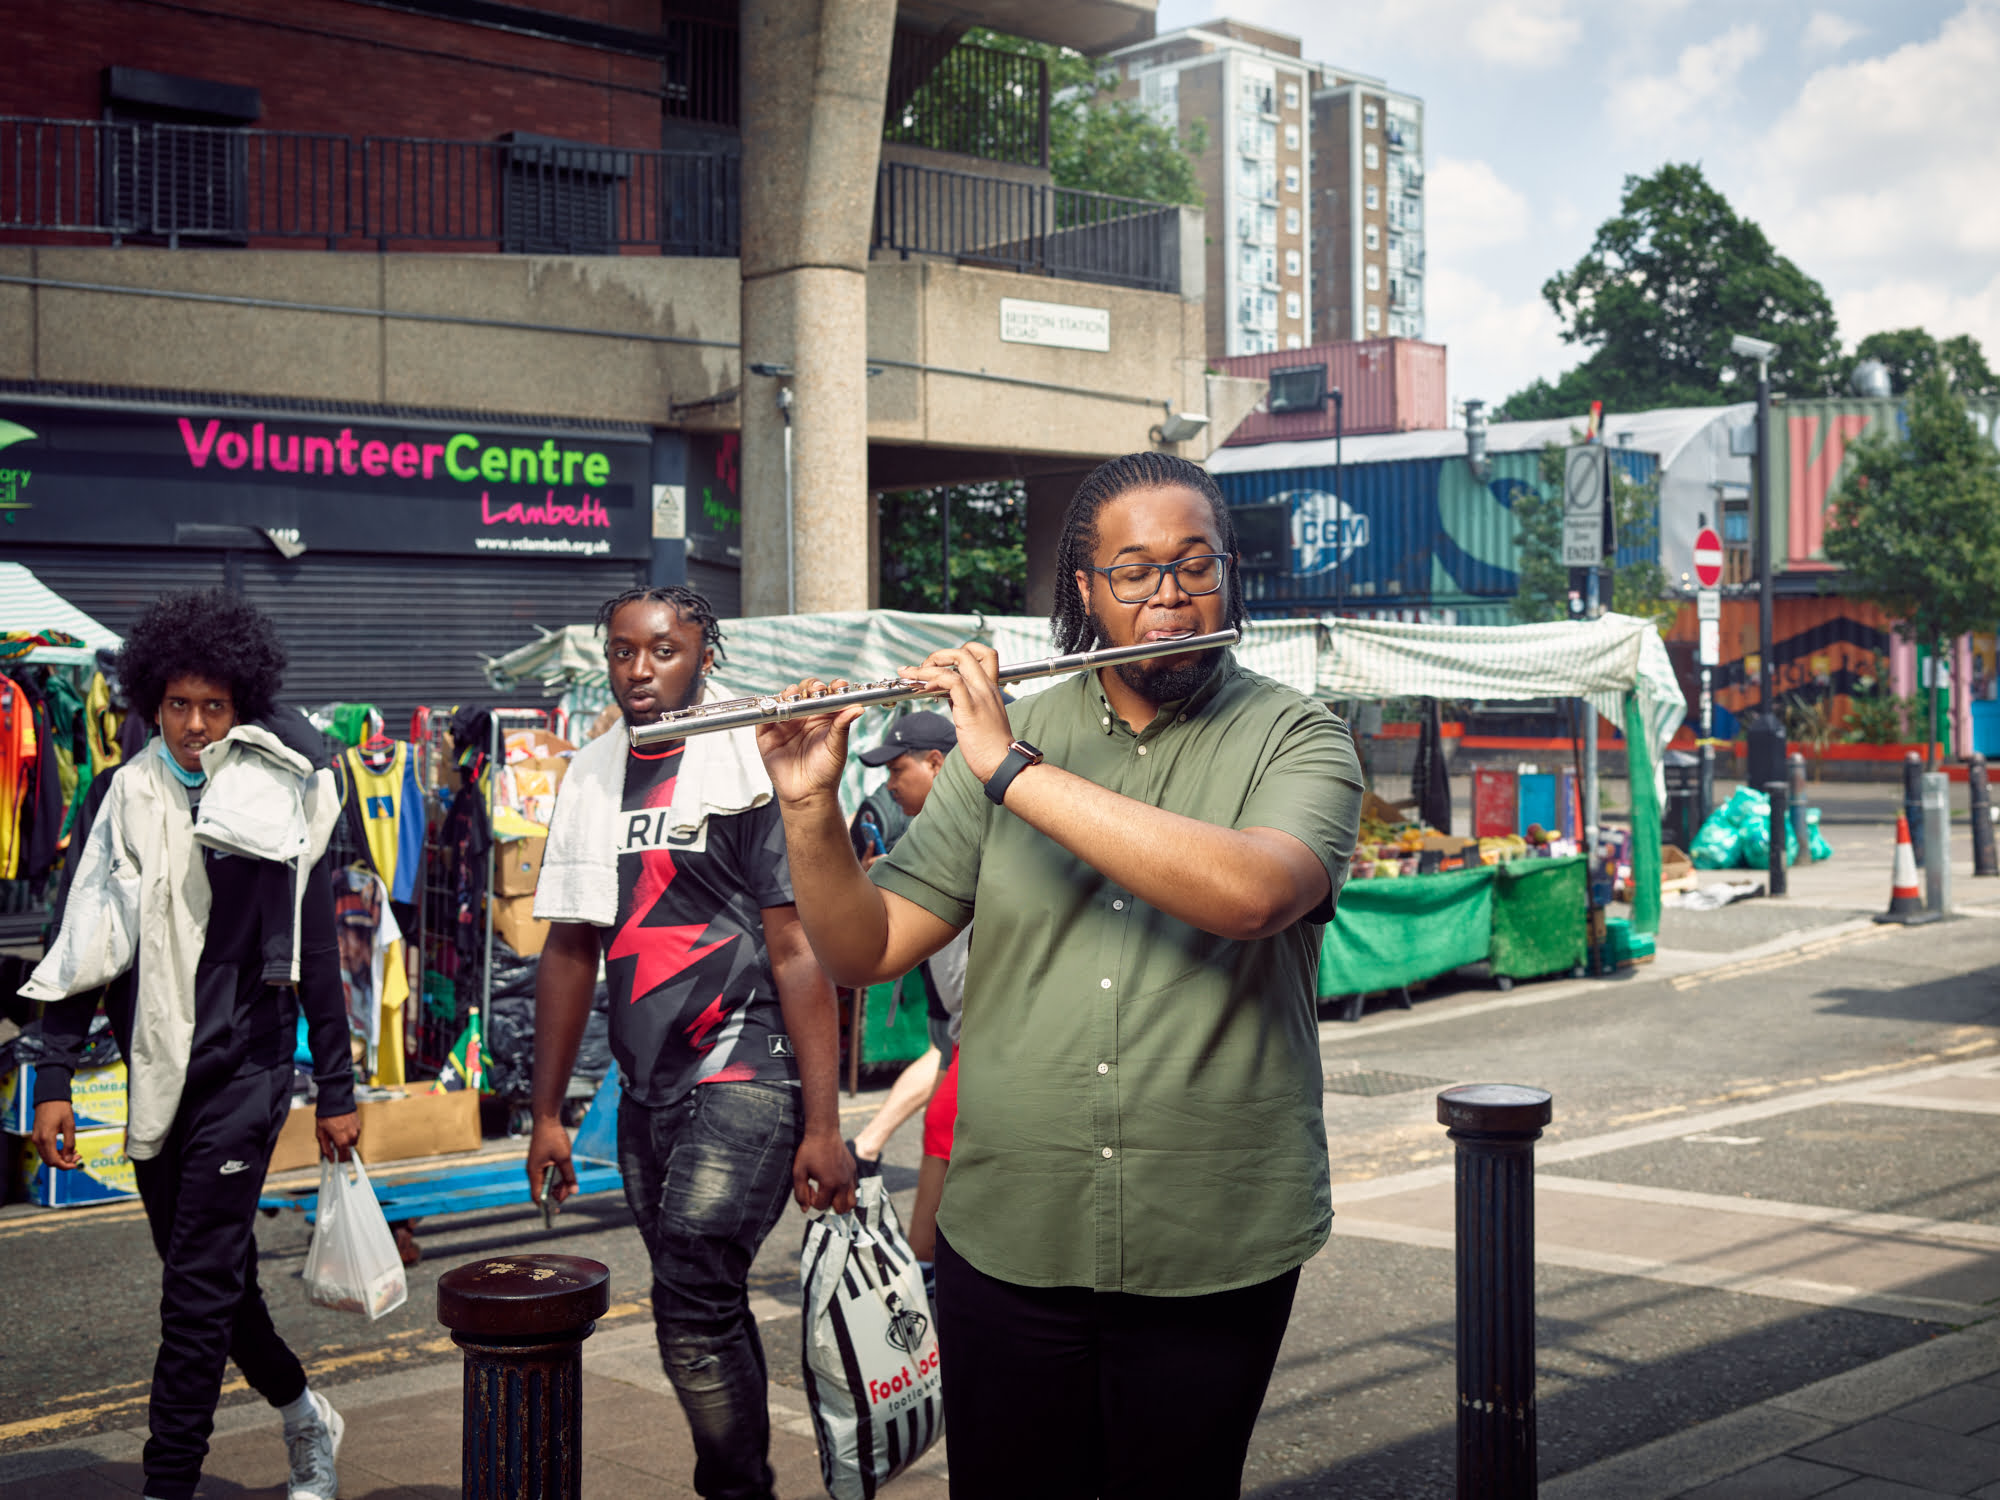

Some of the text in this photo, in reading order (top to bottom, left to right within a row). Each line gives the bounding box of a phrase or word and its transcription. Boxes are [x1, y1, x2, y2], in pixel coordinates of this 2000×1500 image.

[481, 489, 611, 528] Lambeth
[1303, 519, 1366, 544] CGM
[617, 811, 699, 850] RIS
[71, 1082, 127, 1095] OLOMBA
[869, 1366, 913, 1405] Foot
